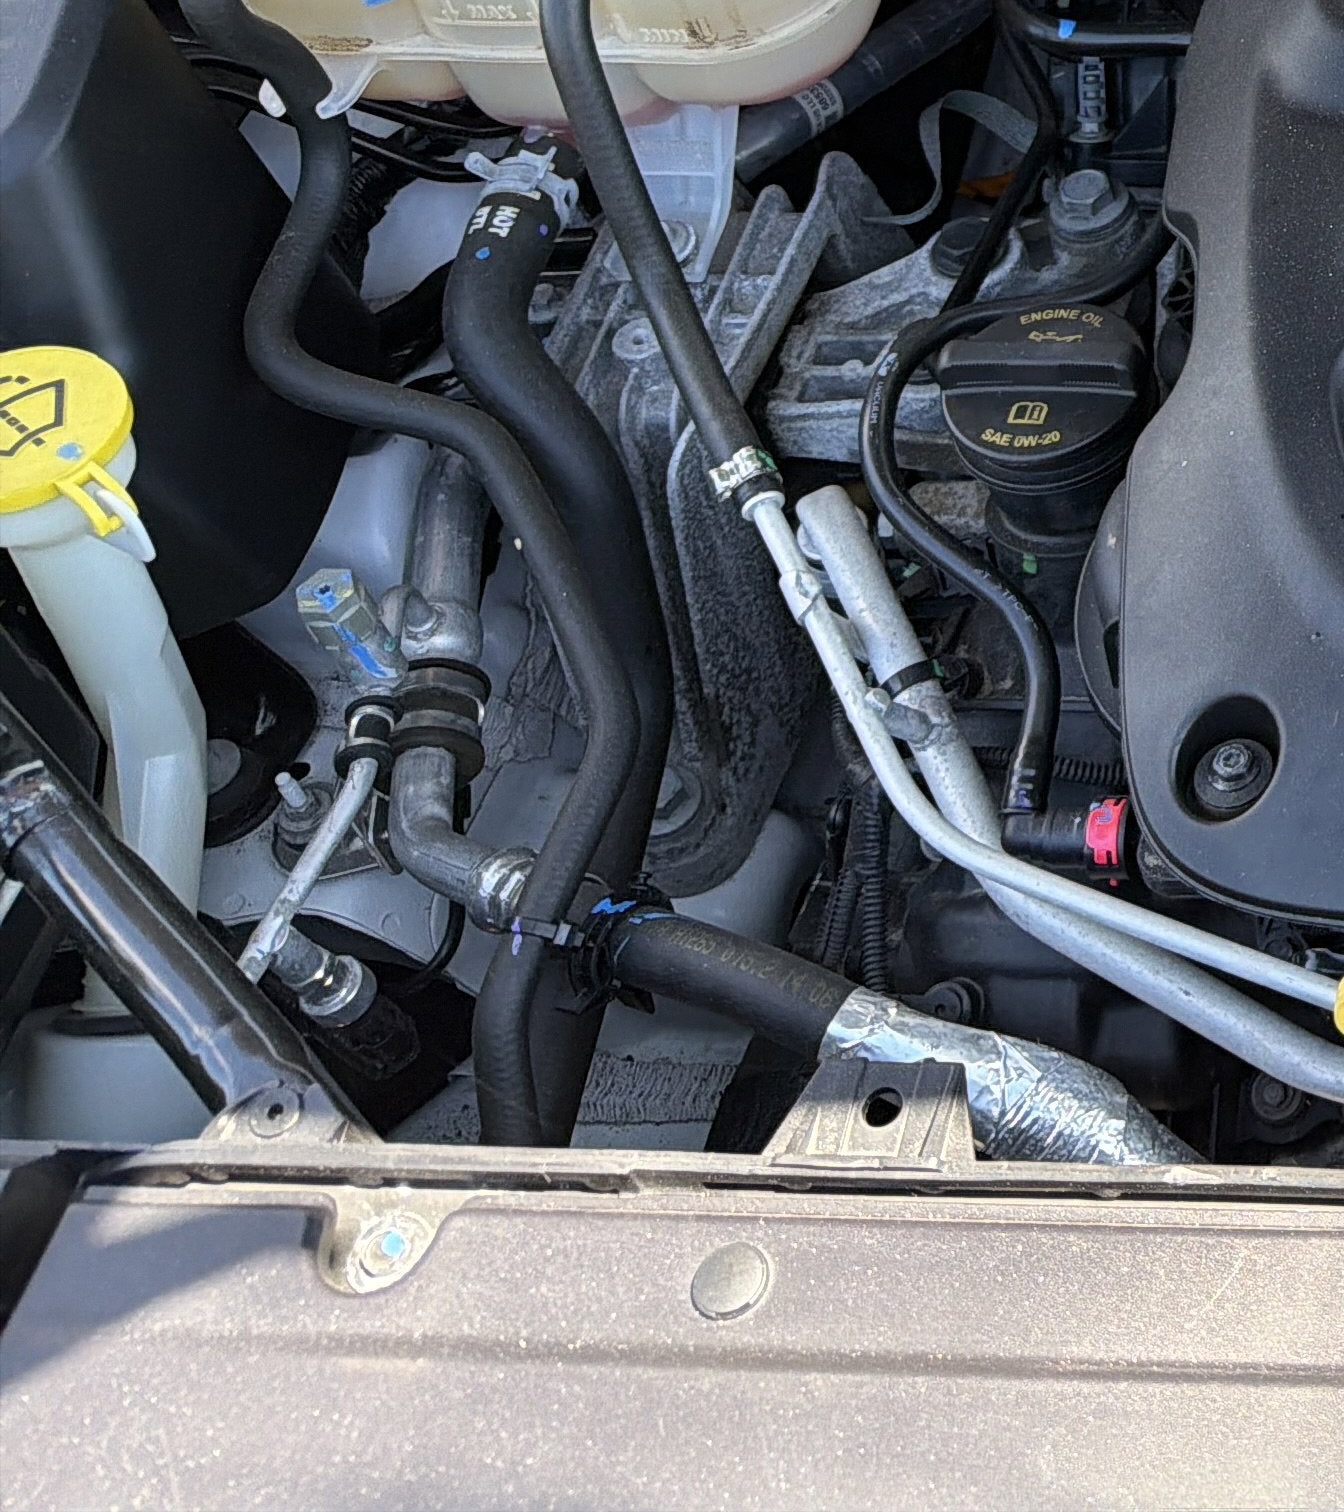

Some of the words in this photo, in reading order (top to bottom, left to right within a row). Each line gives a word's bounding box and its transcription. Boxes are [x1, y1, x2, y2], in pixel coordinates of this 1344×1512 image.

[488, 205, 520, 238] HOT
[1019, 308, 1081, 325] ENGINE
[1082, 311, 1104, 328] OIL
[981, 428, 1014, 446] SAE
[1014, 430, 1061, 448] 0W-20
